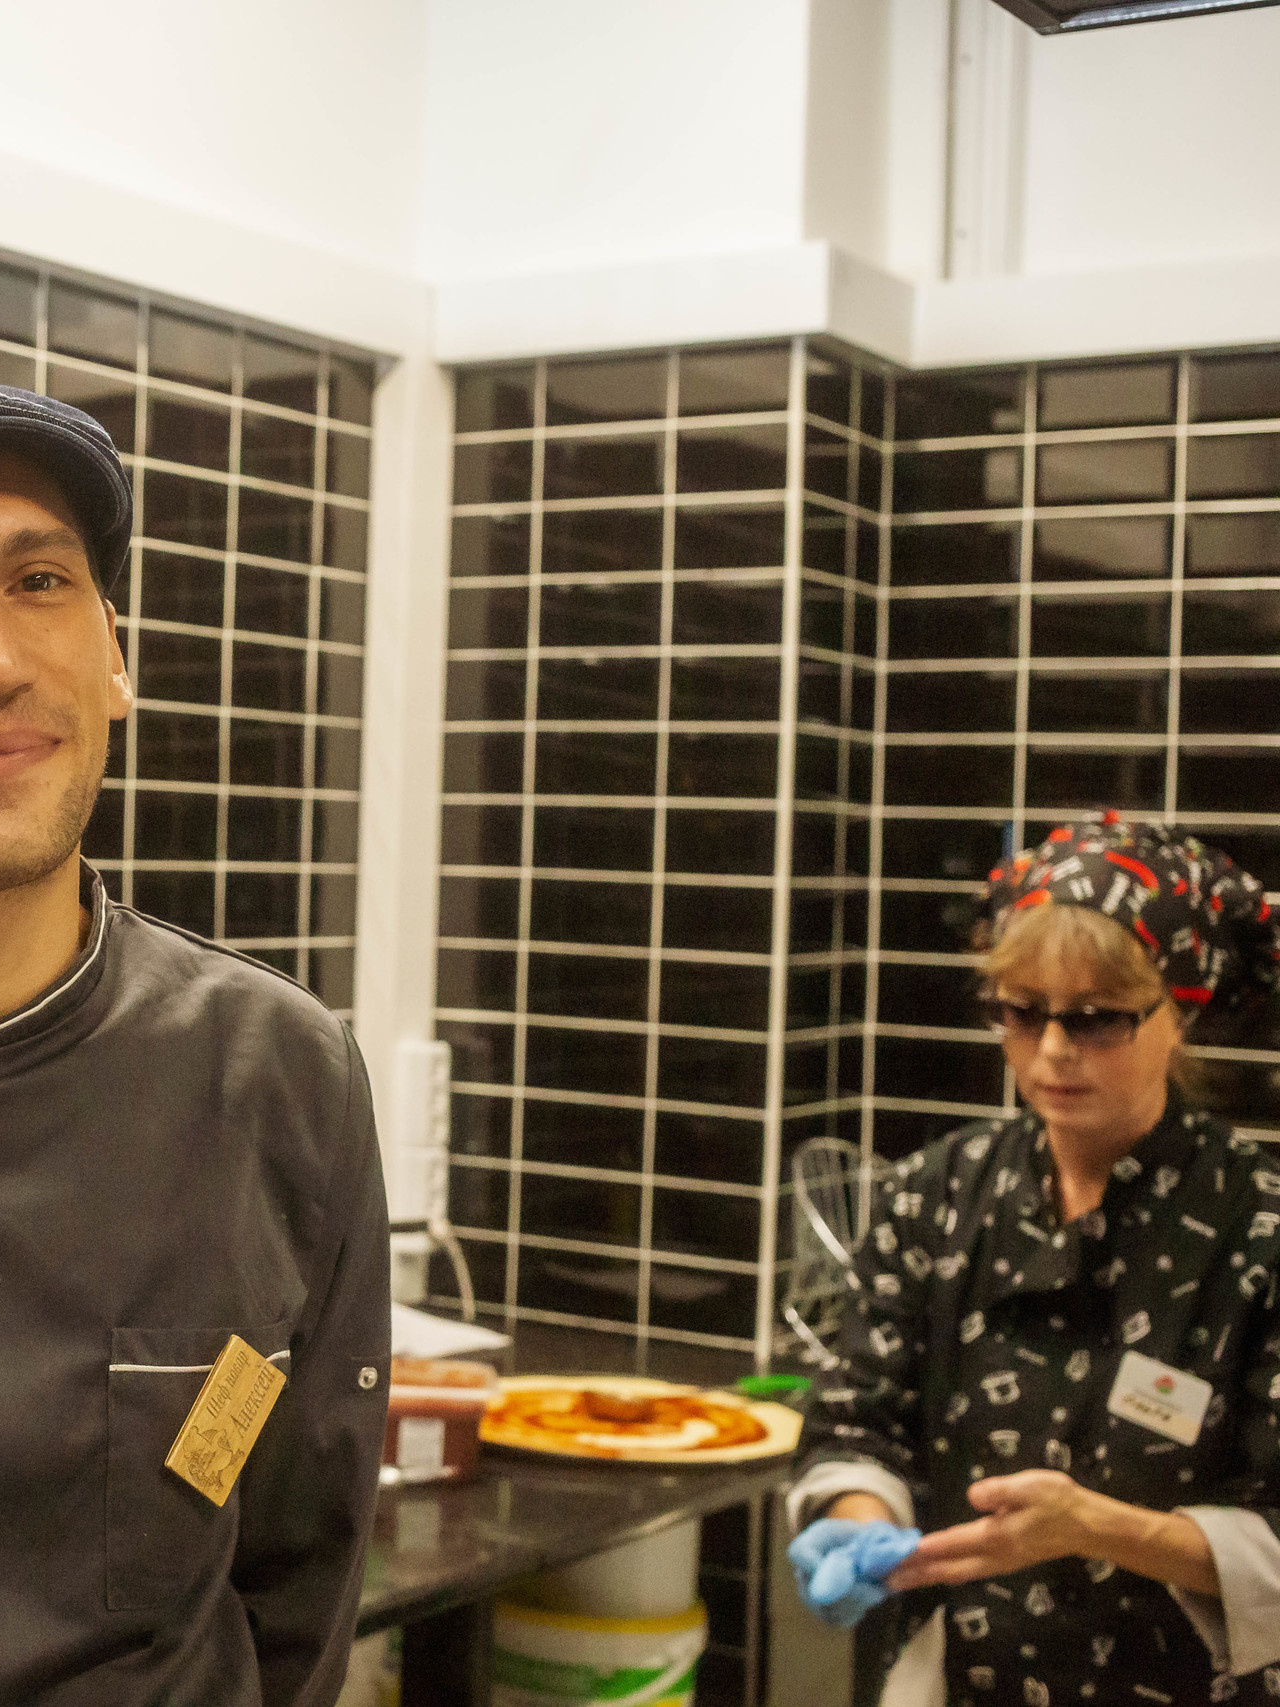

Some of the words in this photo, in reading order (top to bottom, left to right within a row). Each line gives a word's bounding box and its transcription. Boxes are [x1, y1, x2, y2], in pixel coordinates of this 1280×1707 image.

[206, 1383, 232, 1419] Шеф
[226, 1350, 250, 1388] повар
[229, 1363, 276, 1439] Алексей
